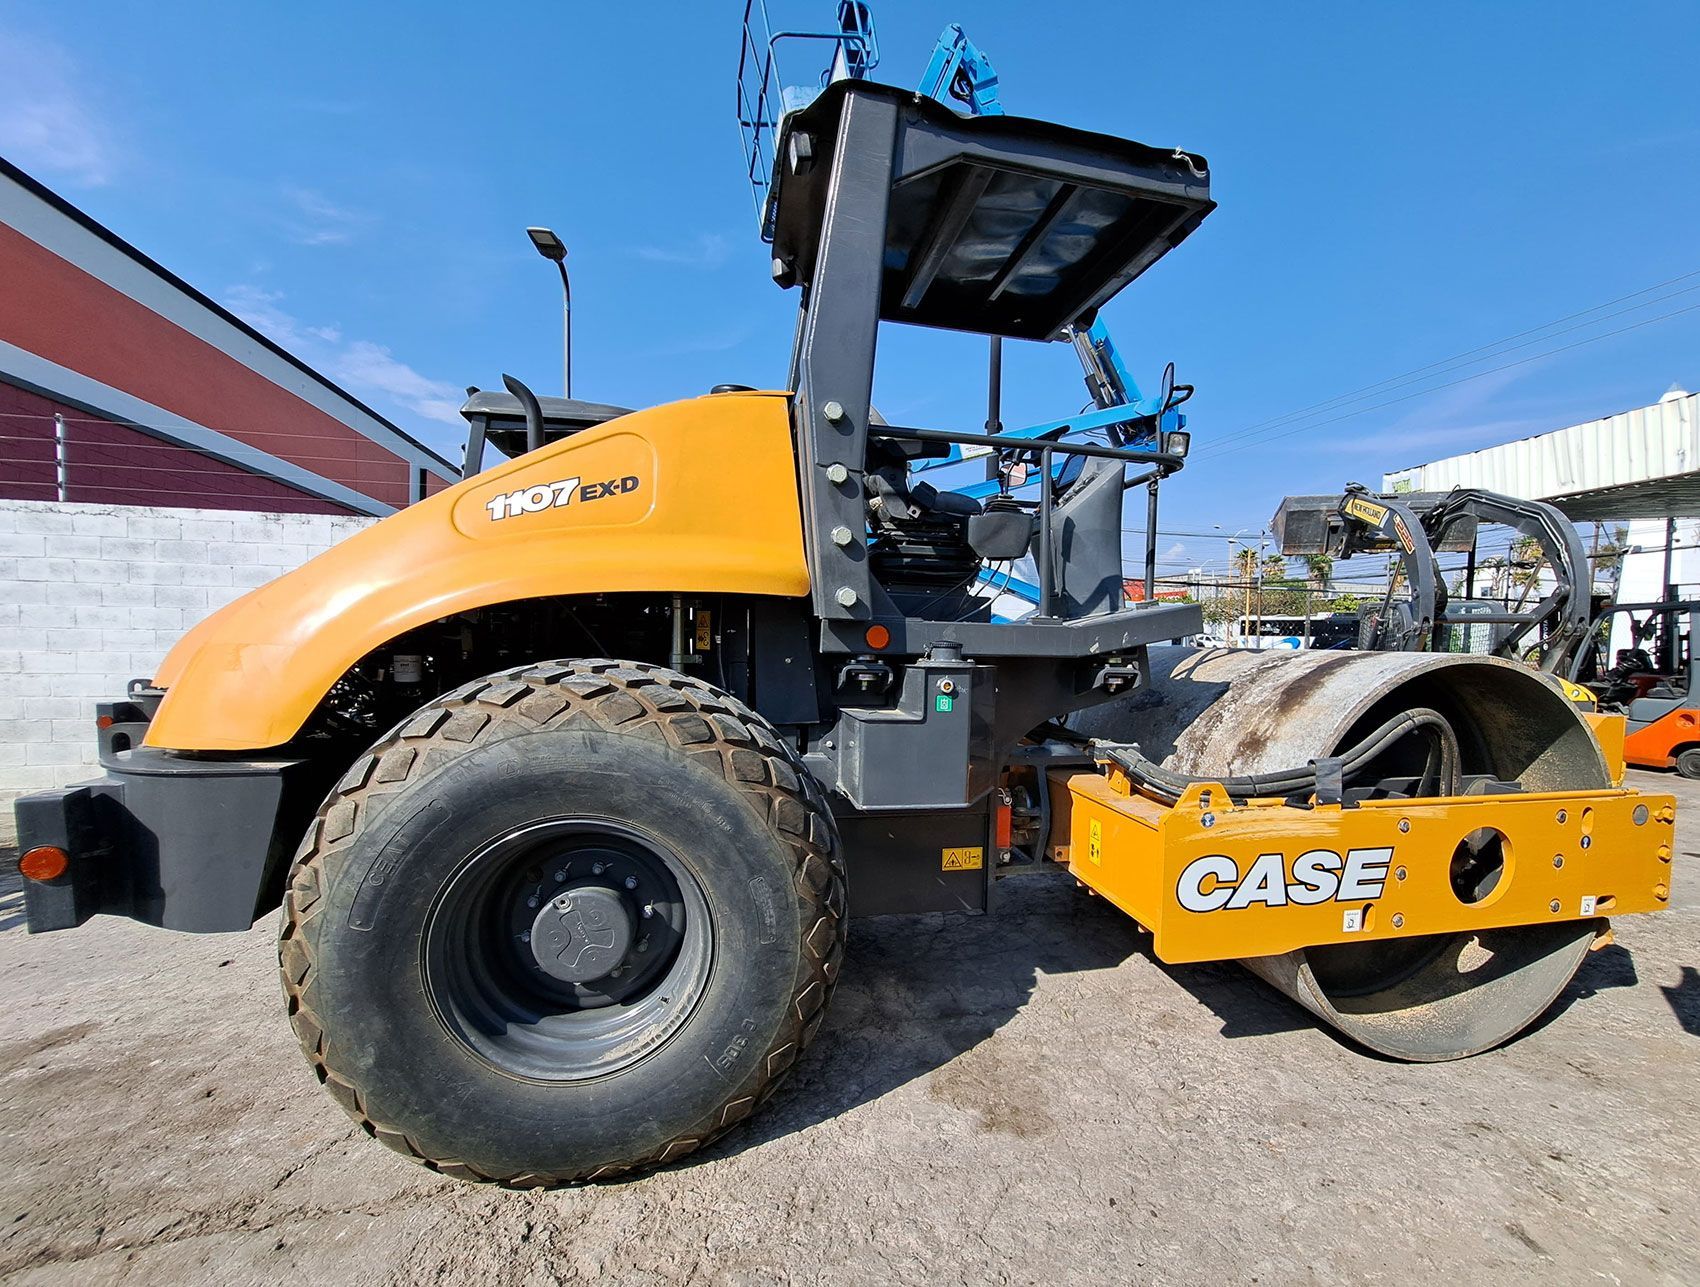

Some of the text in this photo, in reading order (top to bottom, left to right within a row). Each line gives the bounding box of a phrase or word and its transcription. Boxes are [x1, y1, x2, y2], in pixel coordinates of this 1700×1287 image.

[486, 475, 640, 521] 1107 EX-D
[1362, 504, 1382, 520] HOLLAND
[368, 832, 411, 886] CEAT
[1176, 846, 1395, 914] CASE
